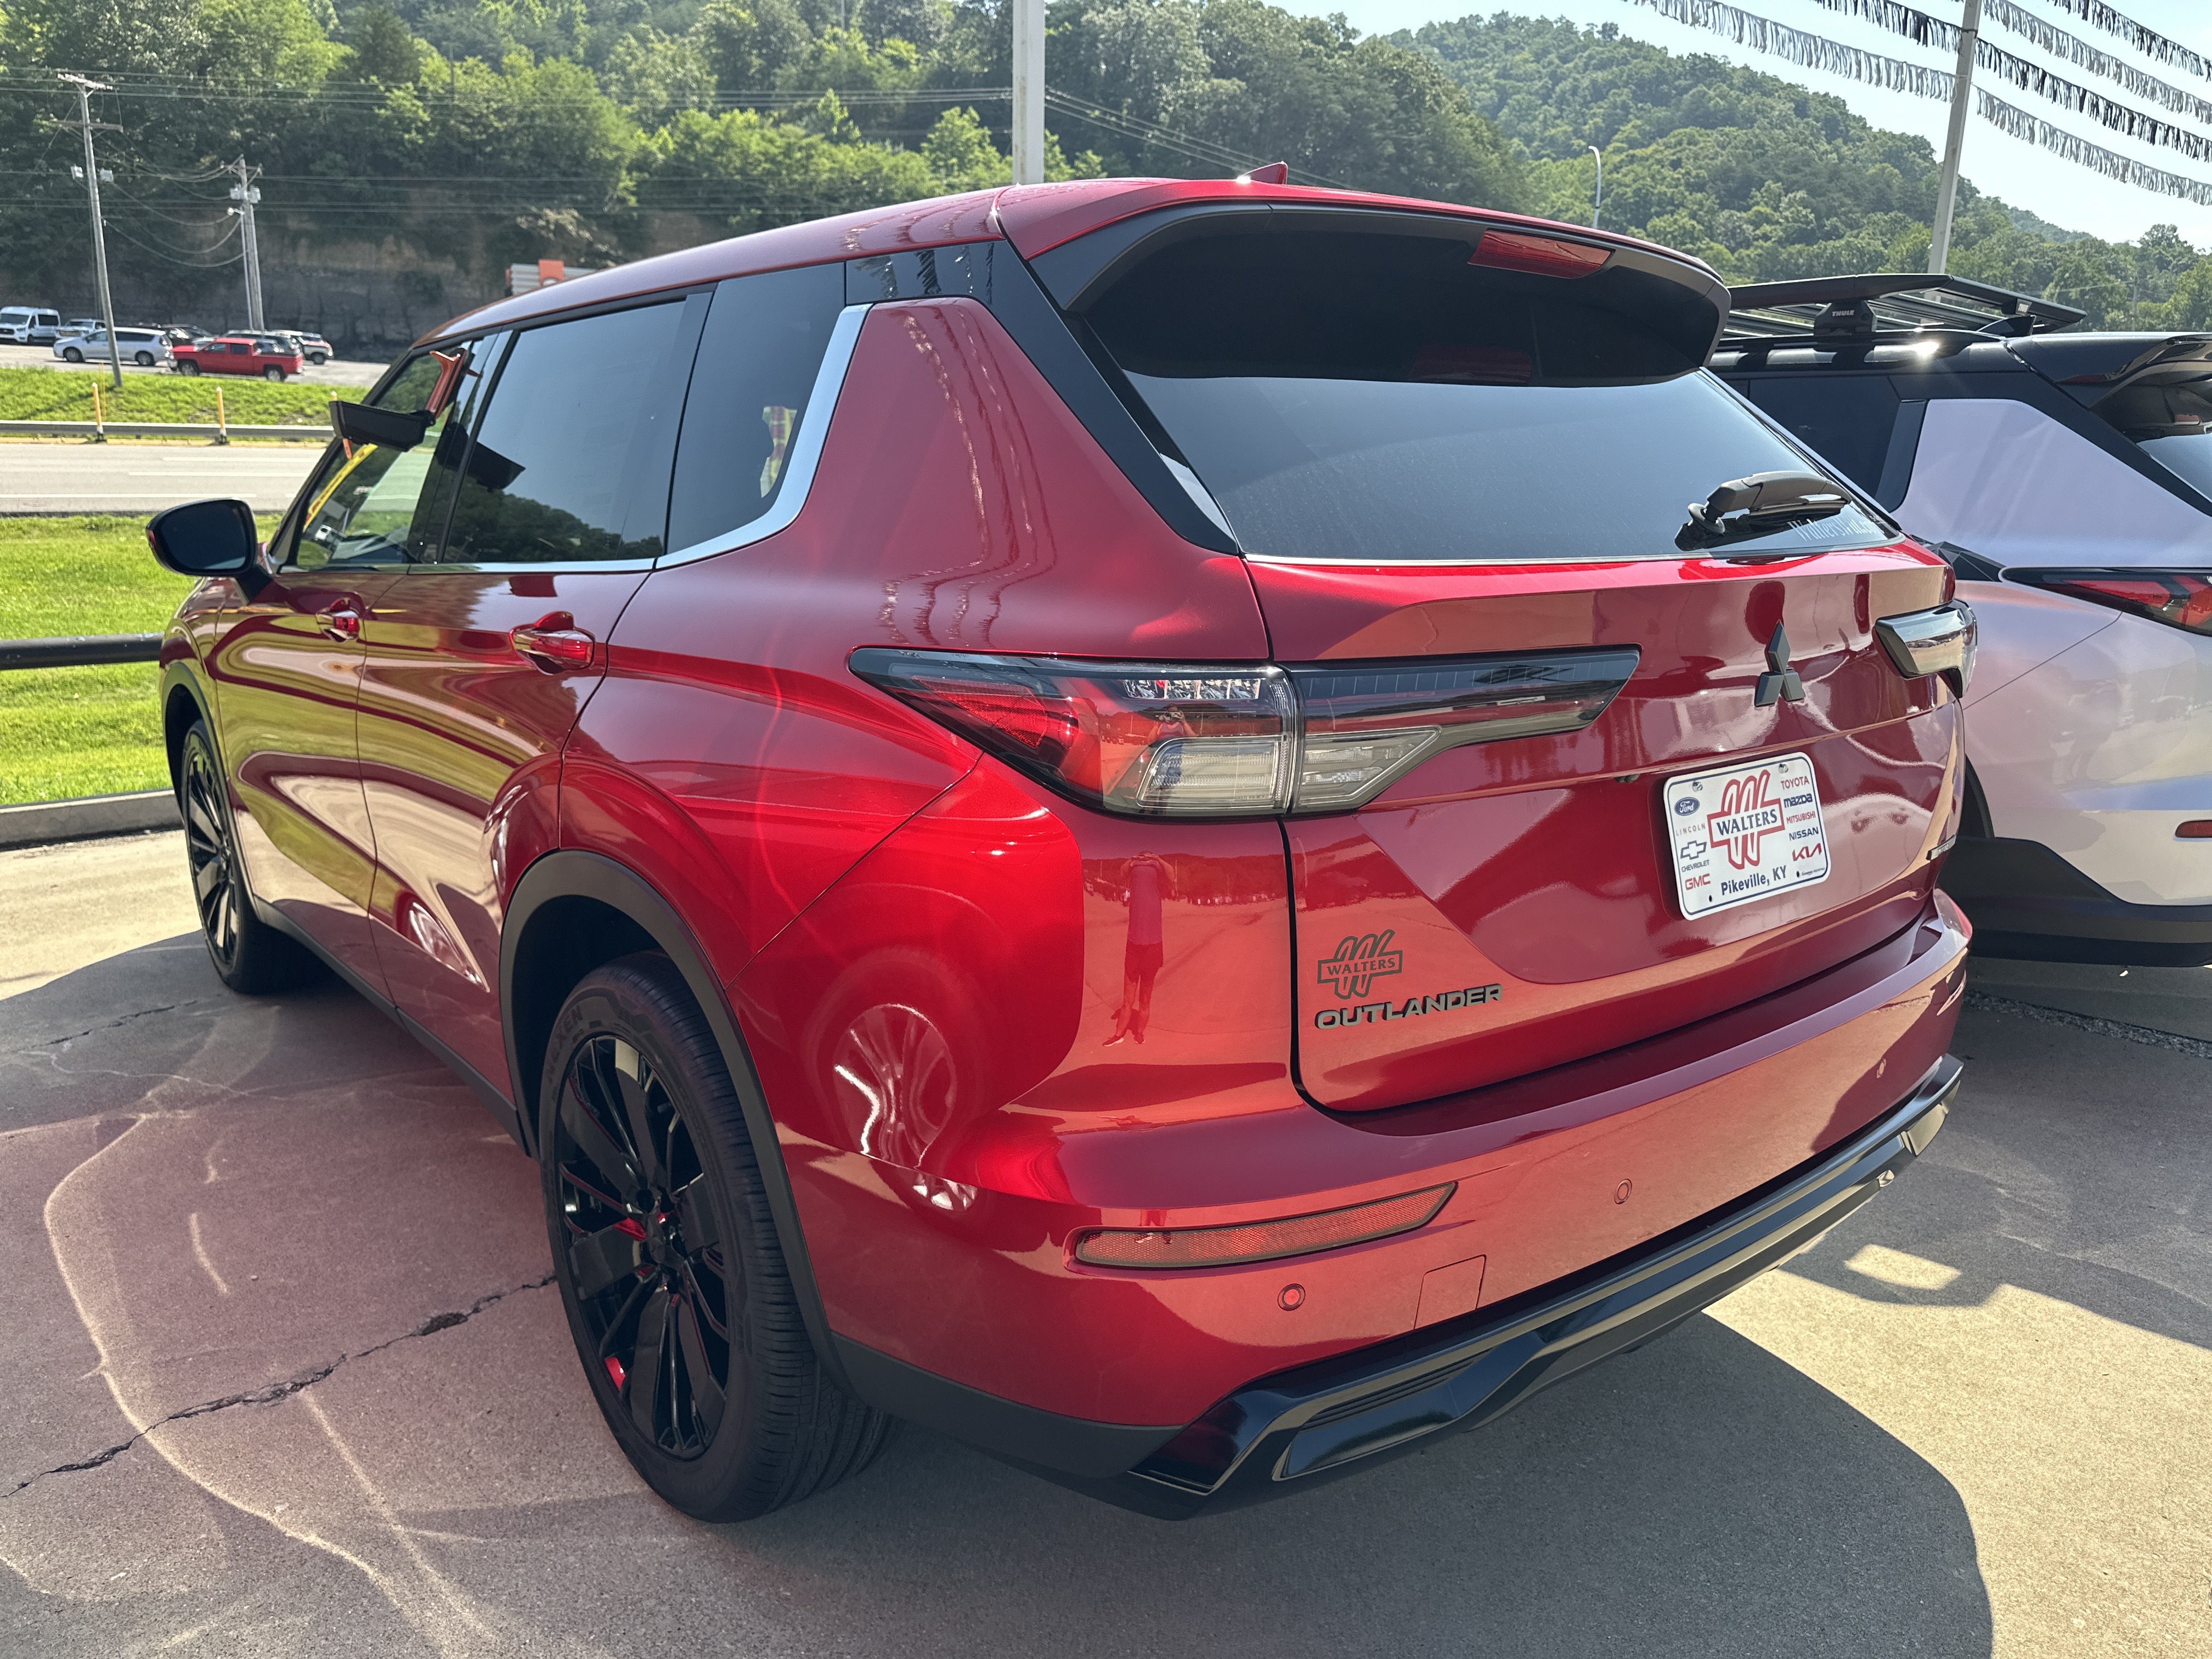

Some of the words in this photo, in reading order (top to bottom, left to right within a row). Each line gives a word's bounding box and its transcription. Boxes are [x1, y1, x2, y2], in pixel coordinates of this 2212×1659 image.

[1781, 776, 1809, 790] TOYOTA
[1716, 809, 1778, 836] WALTERS
[1786, 811, 1816, 824] MITSUBISHI
[1676, 823, 1706, 836] LINCOLN
[1788, 827, 1819, 840] NISSAN
[1792, 843, 1822, 861] KIA
[1681, 859, 1709, 872] CHEVROLET
[1685, 873, 1711, 890] GMC
[1720, 873, 1770, 895] Pikeville,
[1773, 865, 1787, 882] KY
[1327, 957, 1396, 975] WALTERS
[1315, 983, 1503, 1030] OUTLANDER
